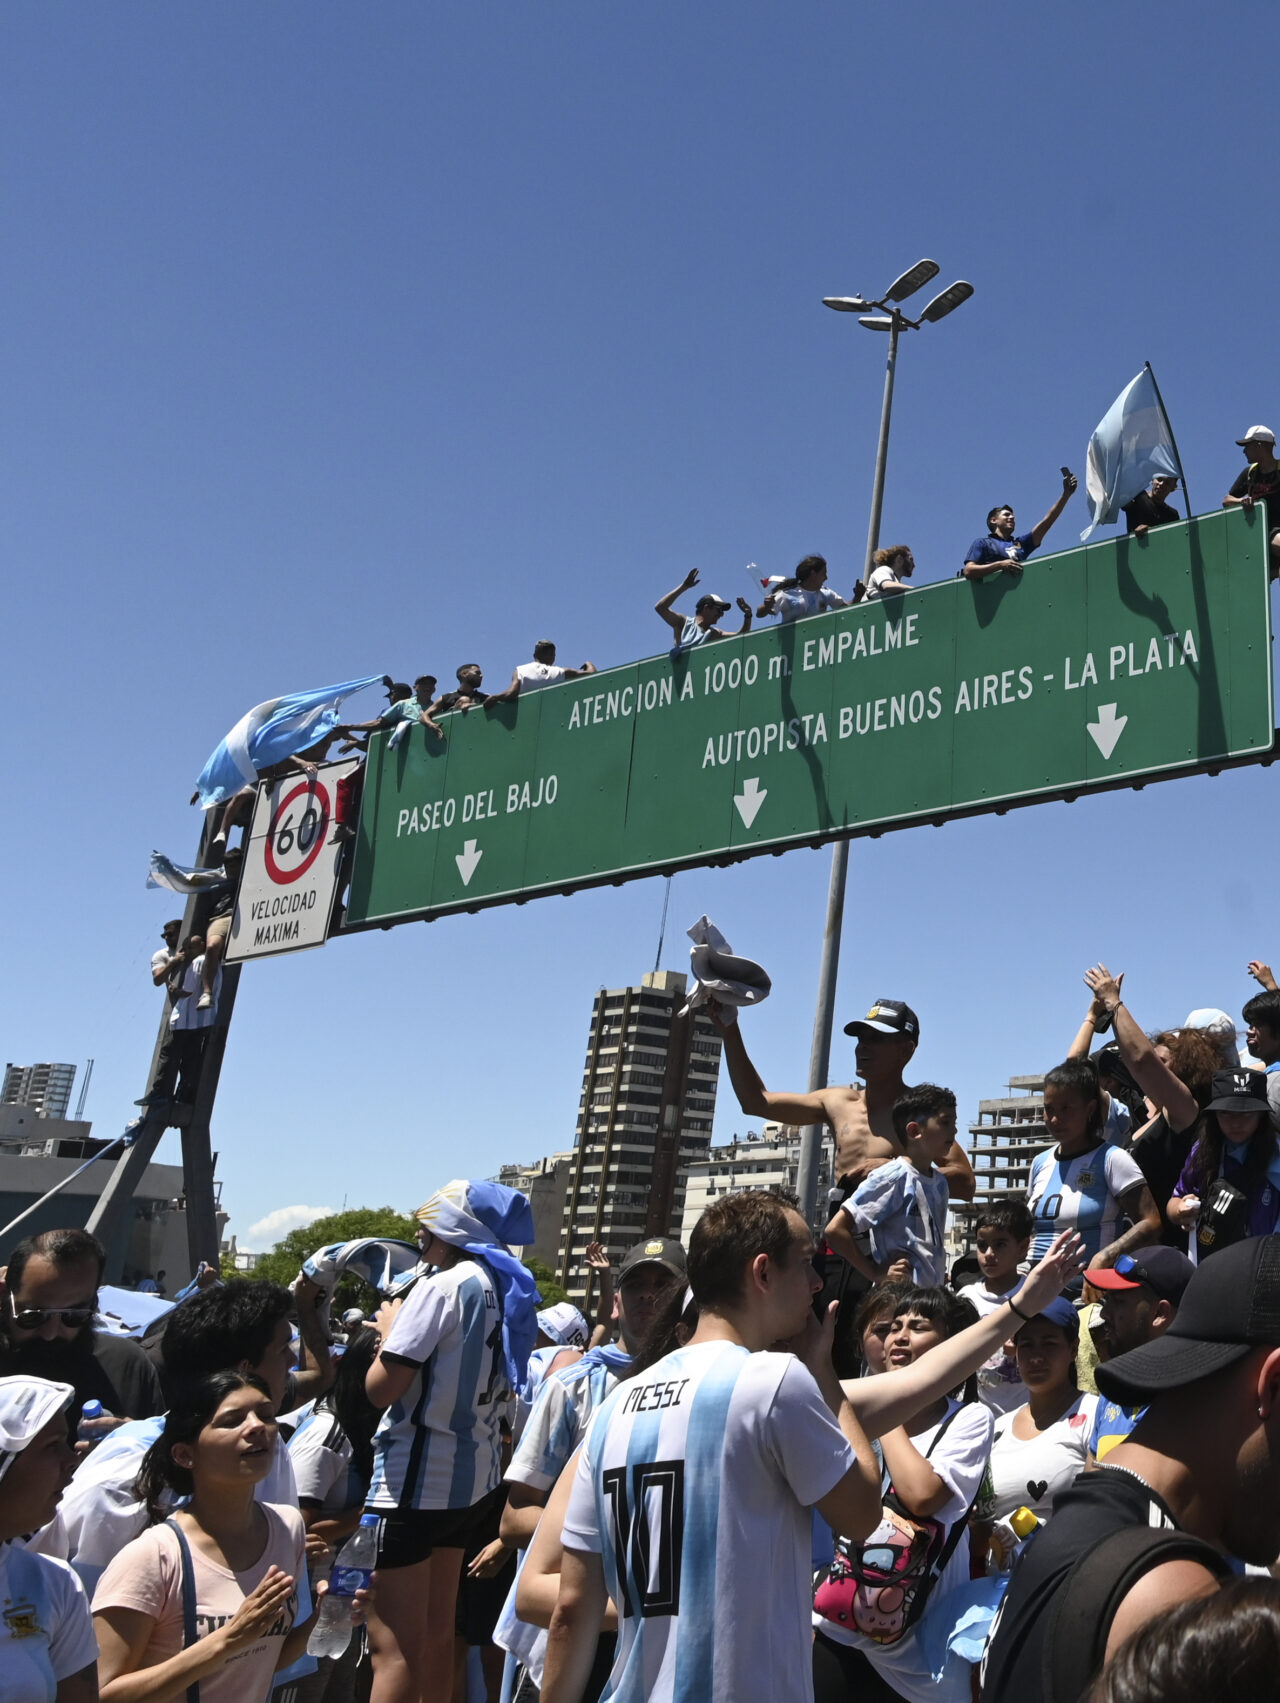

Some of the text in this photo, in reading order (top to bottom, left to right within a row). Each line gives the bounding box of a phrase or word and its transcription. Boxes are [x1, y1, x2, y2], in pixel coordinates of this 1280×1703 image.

[568, 676, 673, 731] ATENCION
[680, 671, 694, 701] A
[704, 654, 759, 695] 1000
[802, 613, 920, 672] EMPALME
[701, 712, 828, 769] AUTOPISTA
[838, 686, 943, 739] BUENOS
[954, 665, 1033, 715] AIRES
[1064, 652, 1098, 690] LA
[1110, 629, 1199, 681] PLATA
[276, 807, 318, 856] 60
[396, 775, 558, 838] PASEO DEL BAJO
[251, 889, 317, 920] VELOCIDAD
[254, 920, 300, 946] MAXIMA
[622, 1378, 690, 1415] MESSI
[602, 1459, 685, 1619] 10
